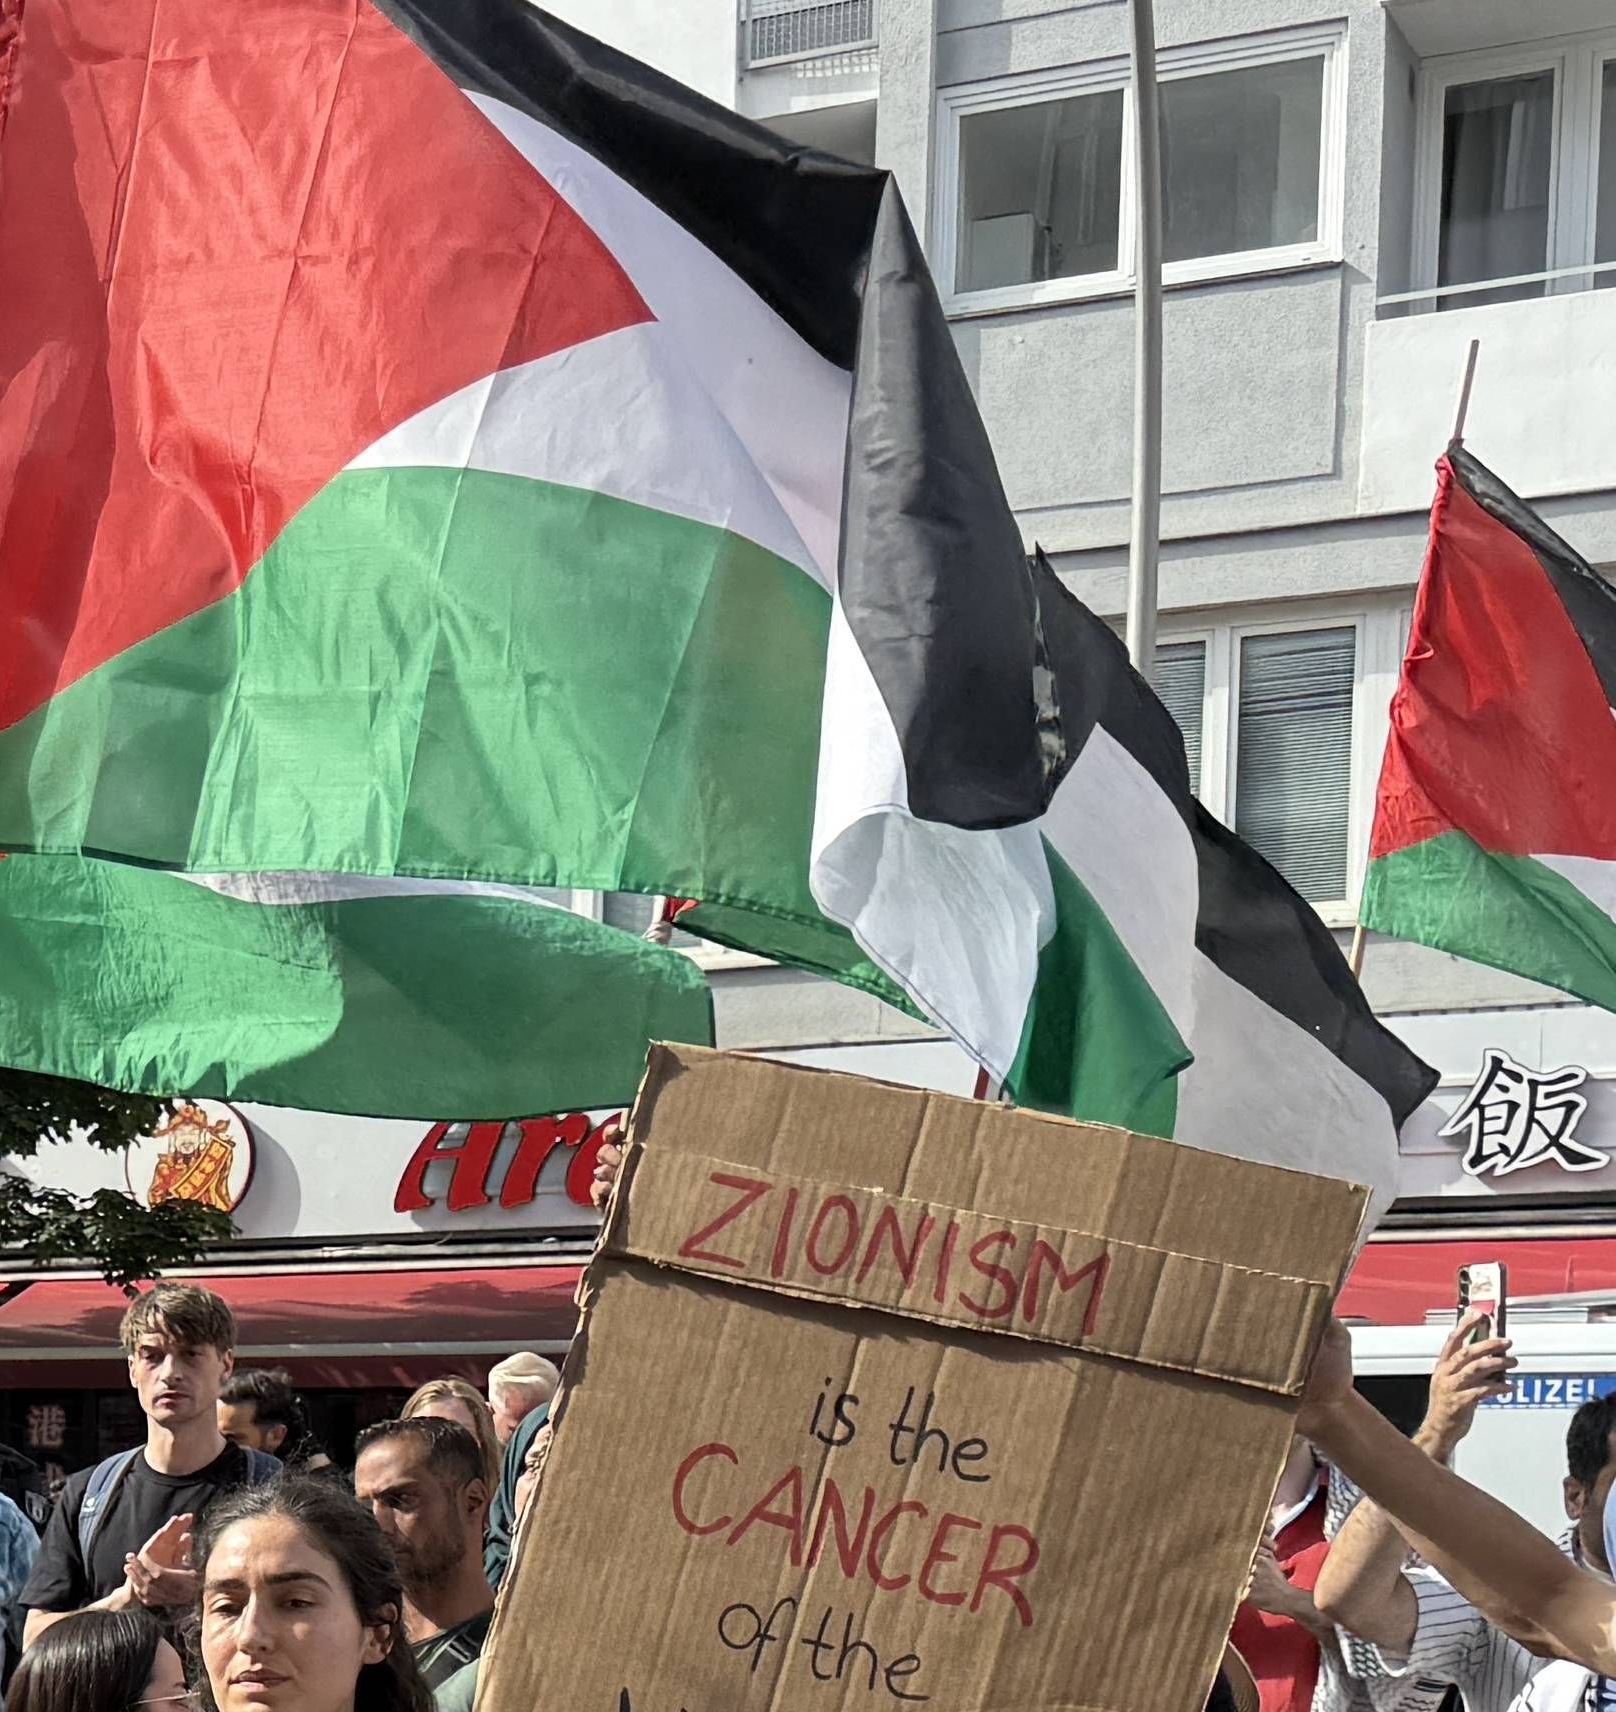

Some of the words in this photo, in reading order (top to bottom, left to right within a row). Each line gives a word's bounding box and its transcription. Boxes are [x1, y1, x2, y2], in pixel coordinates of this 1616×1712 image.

[1438, 1049, 1610, 1176] 飯
[678, 1171, 1111, 1336] ZIONISM
[809, 1377, 859, 1447] is
[889, 1386, 991, 1482] the
[673, 1442, 1040, 1627] CANCER
[718, 1597, 798, 1672] of
[801, 1606, 930, 1701] the
